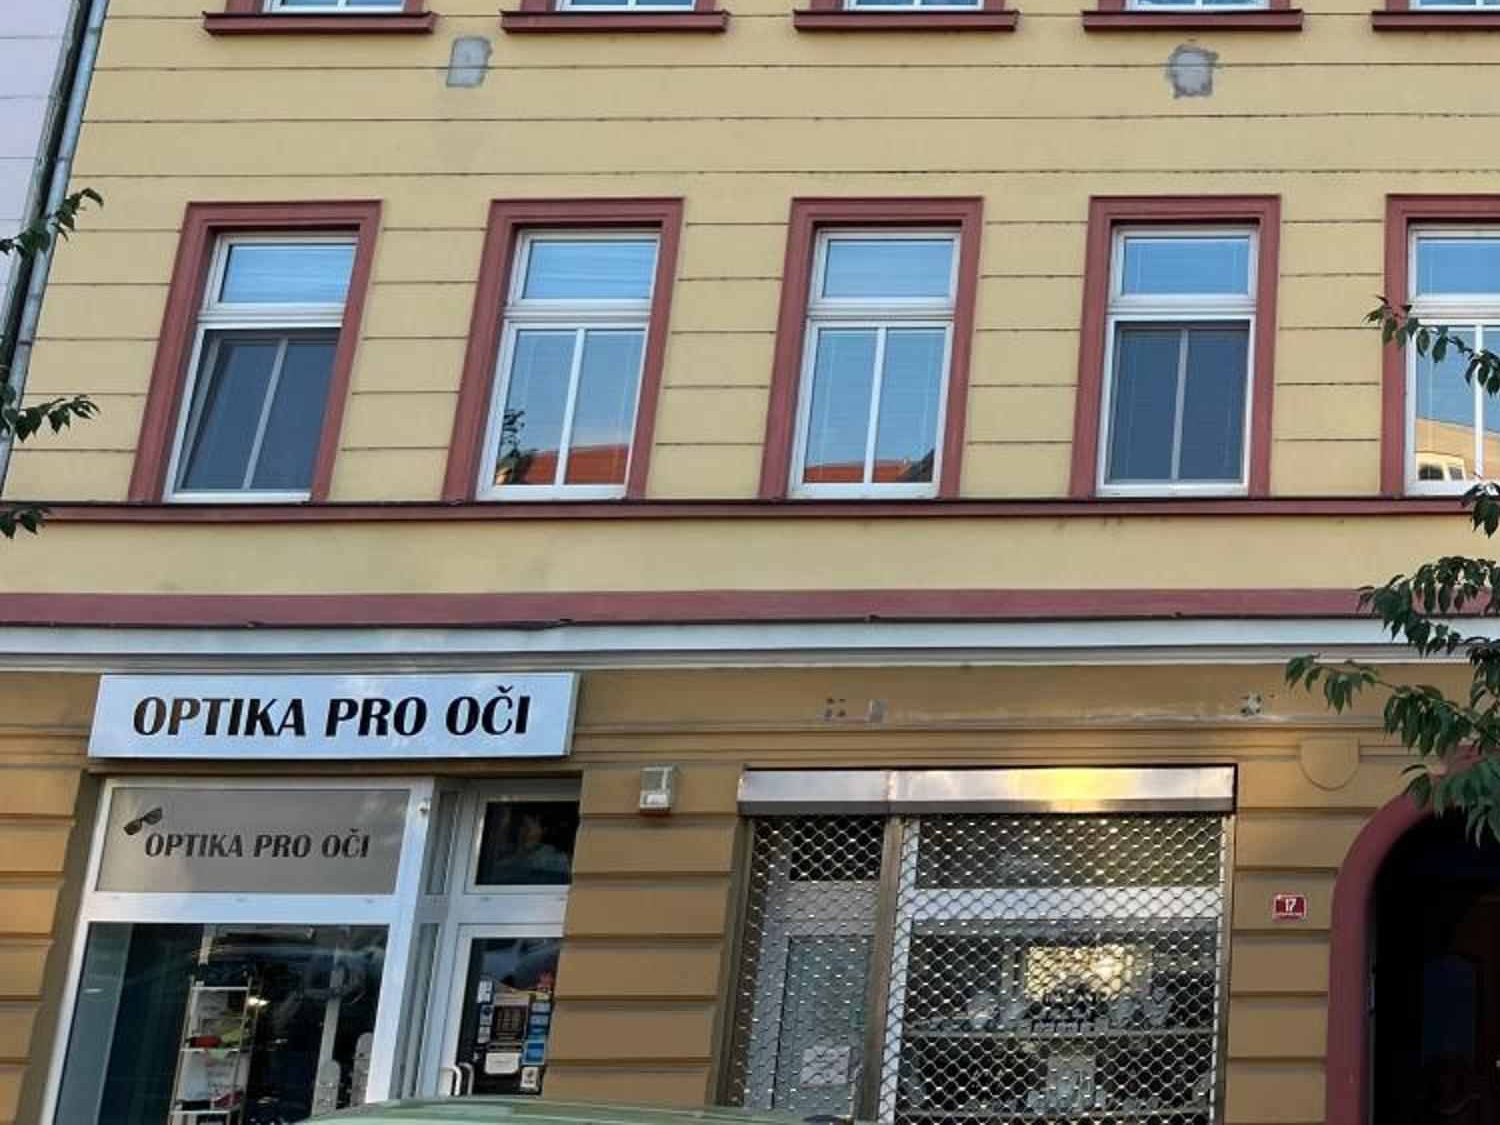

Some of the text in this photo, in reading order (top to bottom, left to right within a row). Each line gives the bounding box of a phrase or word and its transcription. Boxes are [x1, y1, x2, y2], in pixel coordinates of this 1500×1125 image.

[132, 685, 532, 737] OPTIKA PRO OČI
[144, 828, 370, 859] OPTIKA PRO OČI
[1285, 898, 1297, 912] 17
